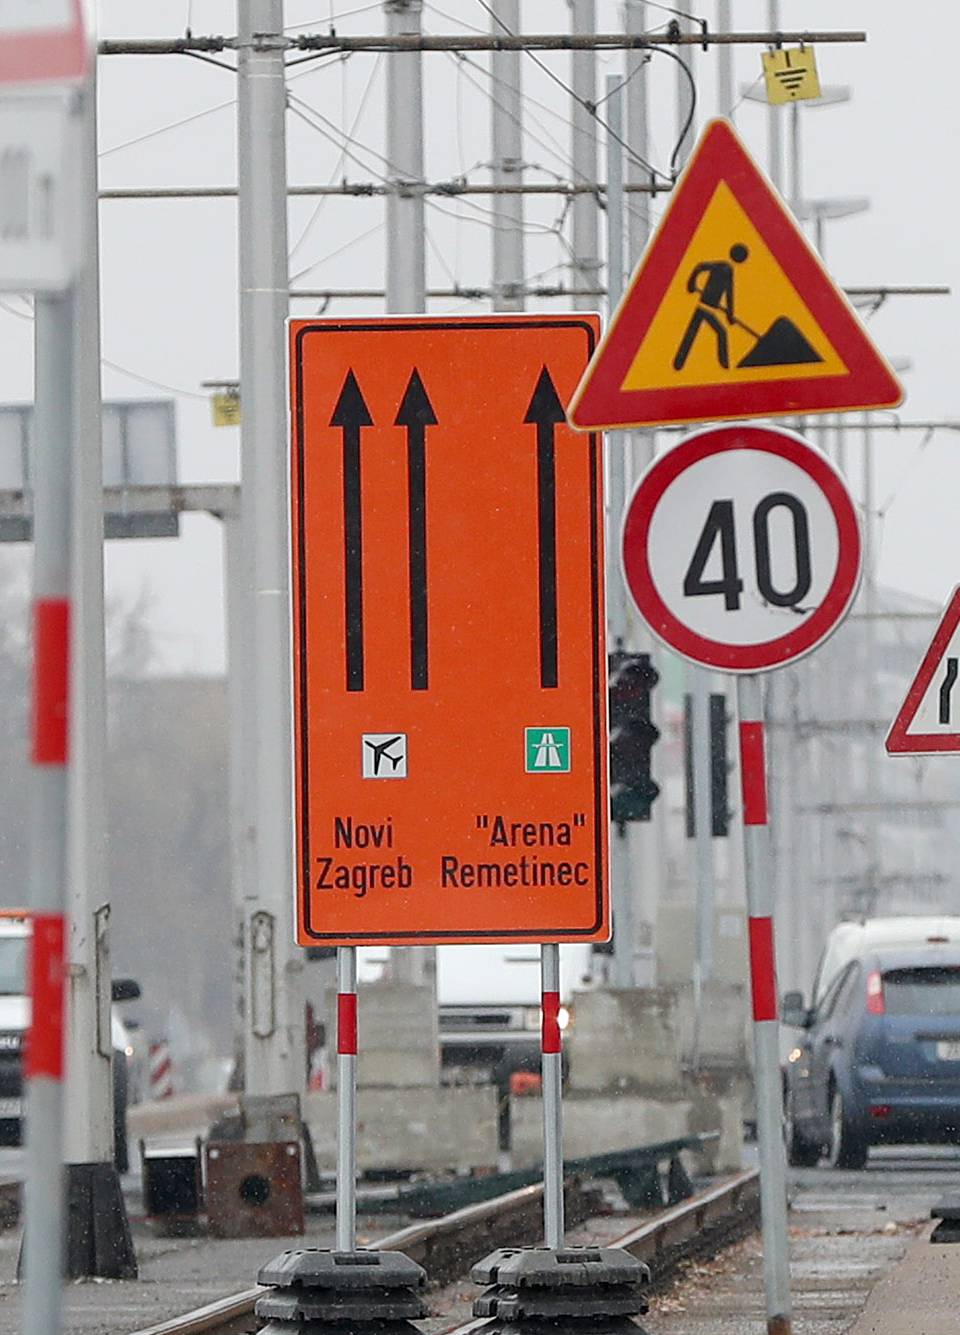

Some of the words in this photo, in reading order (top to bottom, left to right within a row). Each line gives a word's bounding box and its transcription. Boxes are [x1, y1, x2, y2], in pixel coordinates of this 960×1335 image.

[684, 491, 812, 612] 40
[334, 816, 393, 849] Novi
[476, 813, 586, 848] "Arena"
[316, 856, 413, 898] Zagreb
[441, 856, 590, 888] Remetinec
